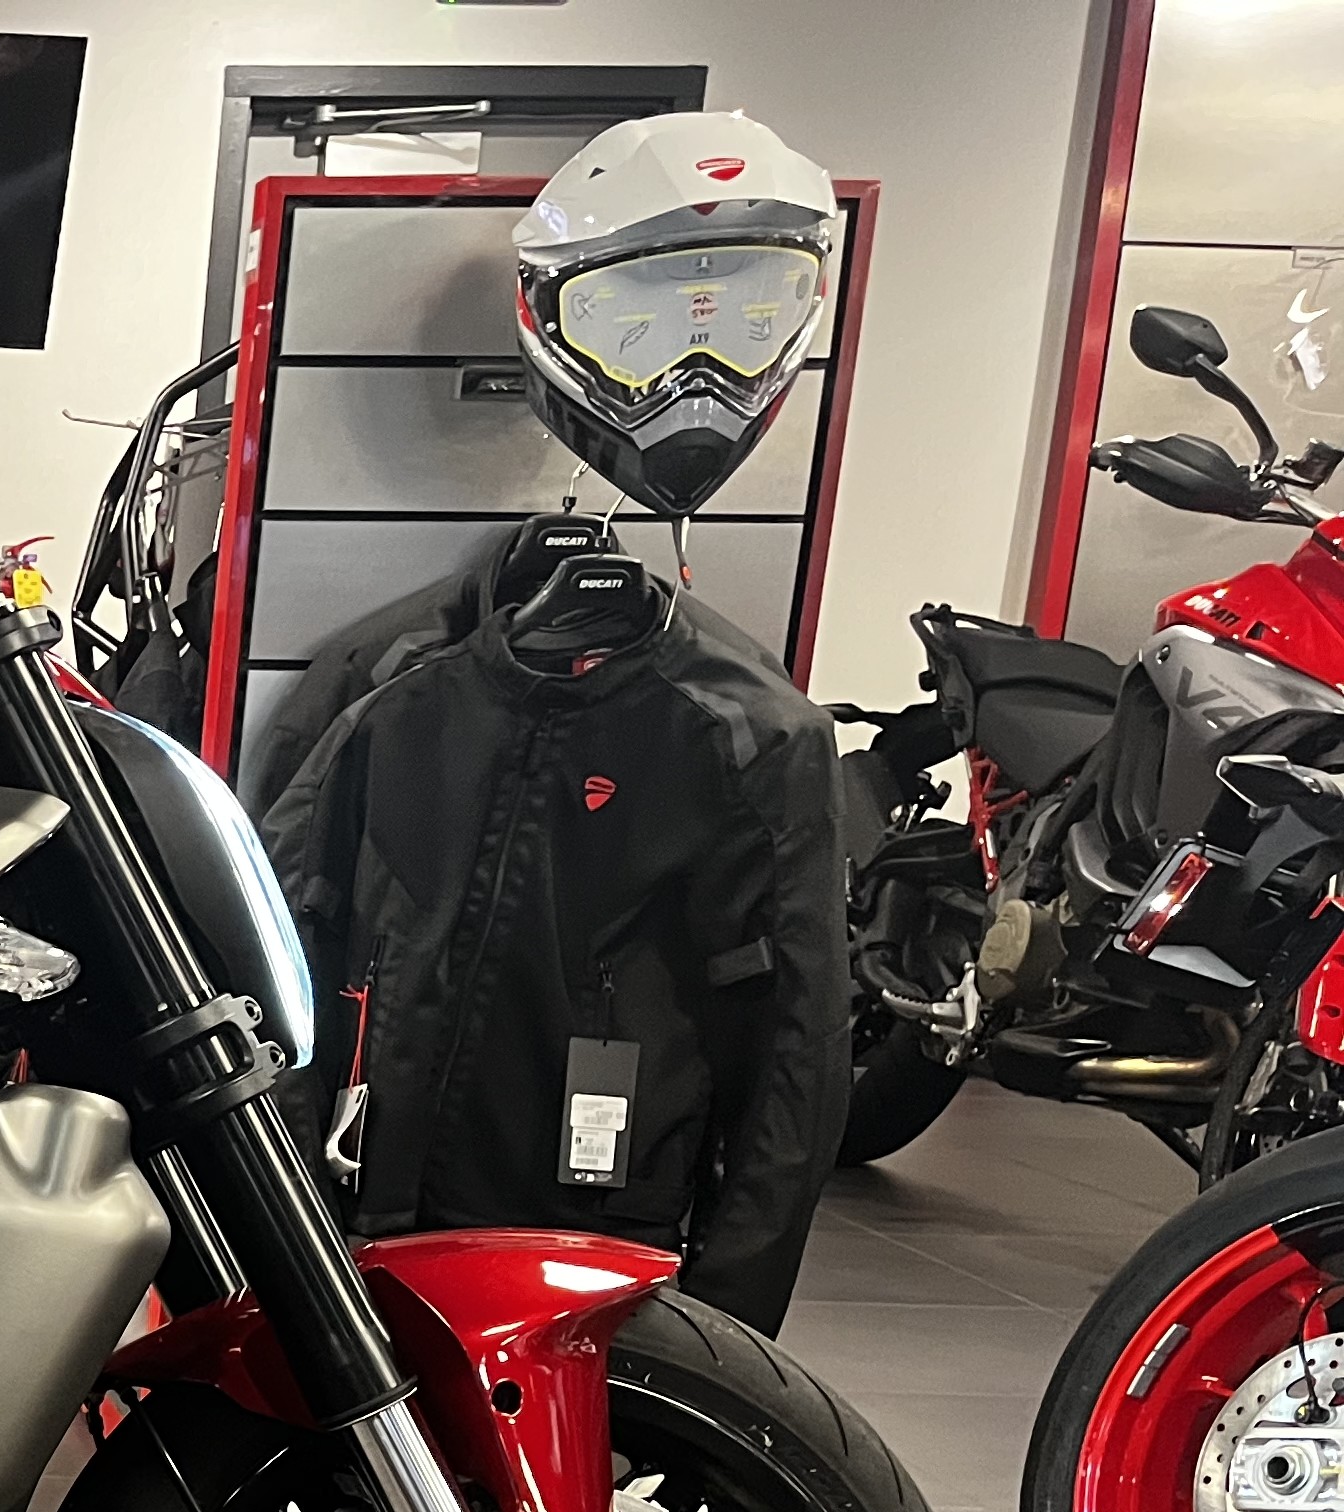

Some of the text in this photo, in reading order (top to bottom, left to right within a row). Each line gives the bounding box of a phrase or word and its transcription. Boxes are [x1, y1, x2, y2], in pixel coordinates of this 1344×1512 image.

[545, 537, 588, 546] DUCATI
[579, 579, 624, 588] DUCATI
[1184, 595, 1241, 628] DUCATI
